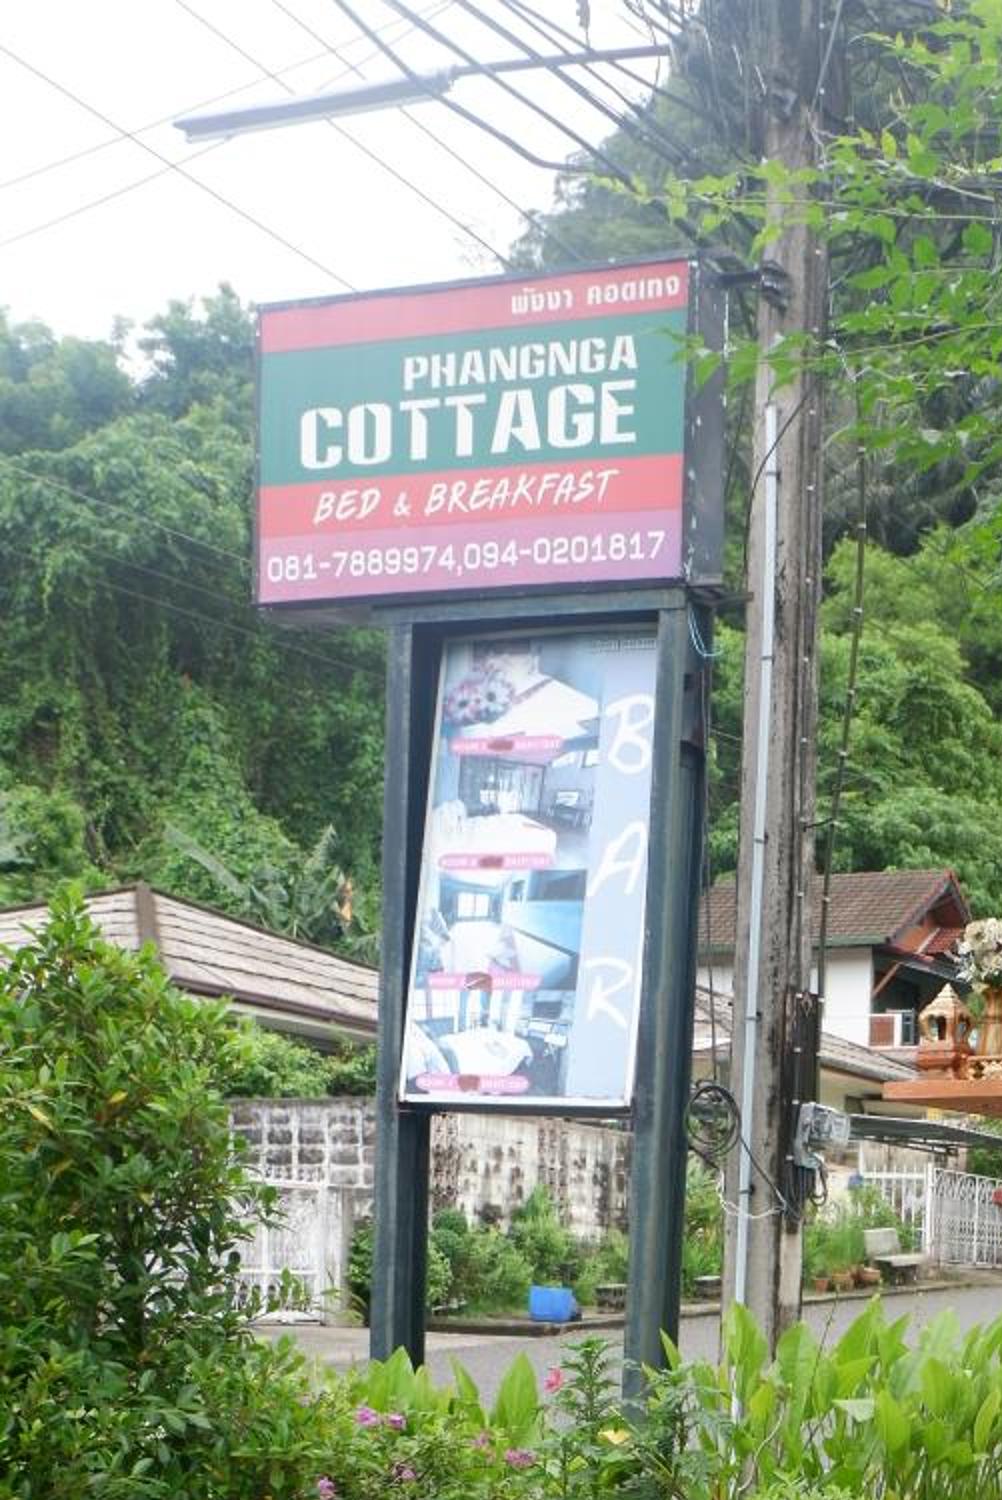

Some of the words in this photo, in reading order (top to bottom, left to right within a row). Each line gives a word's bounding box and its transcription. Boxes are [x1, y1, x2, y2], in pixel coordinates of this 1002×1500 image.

[403, 335, 638, 390] PHANGNGA
[300, 380, 637, 470] COTTAGE
[313, 488, 381, 525] BED
[393, 494, 412, 517] &
[424, 470, 619, 516] BREAKFAST
